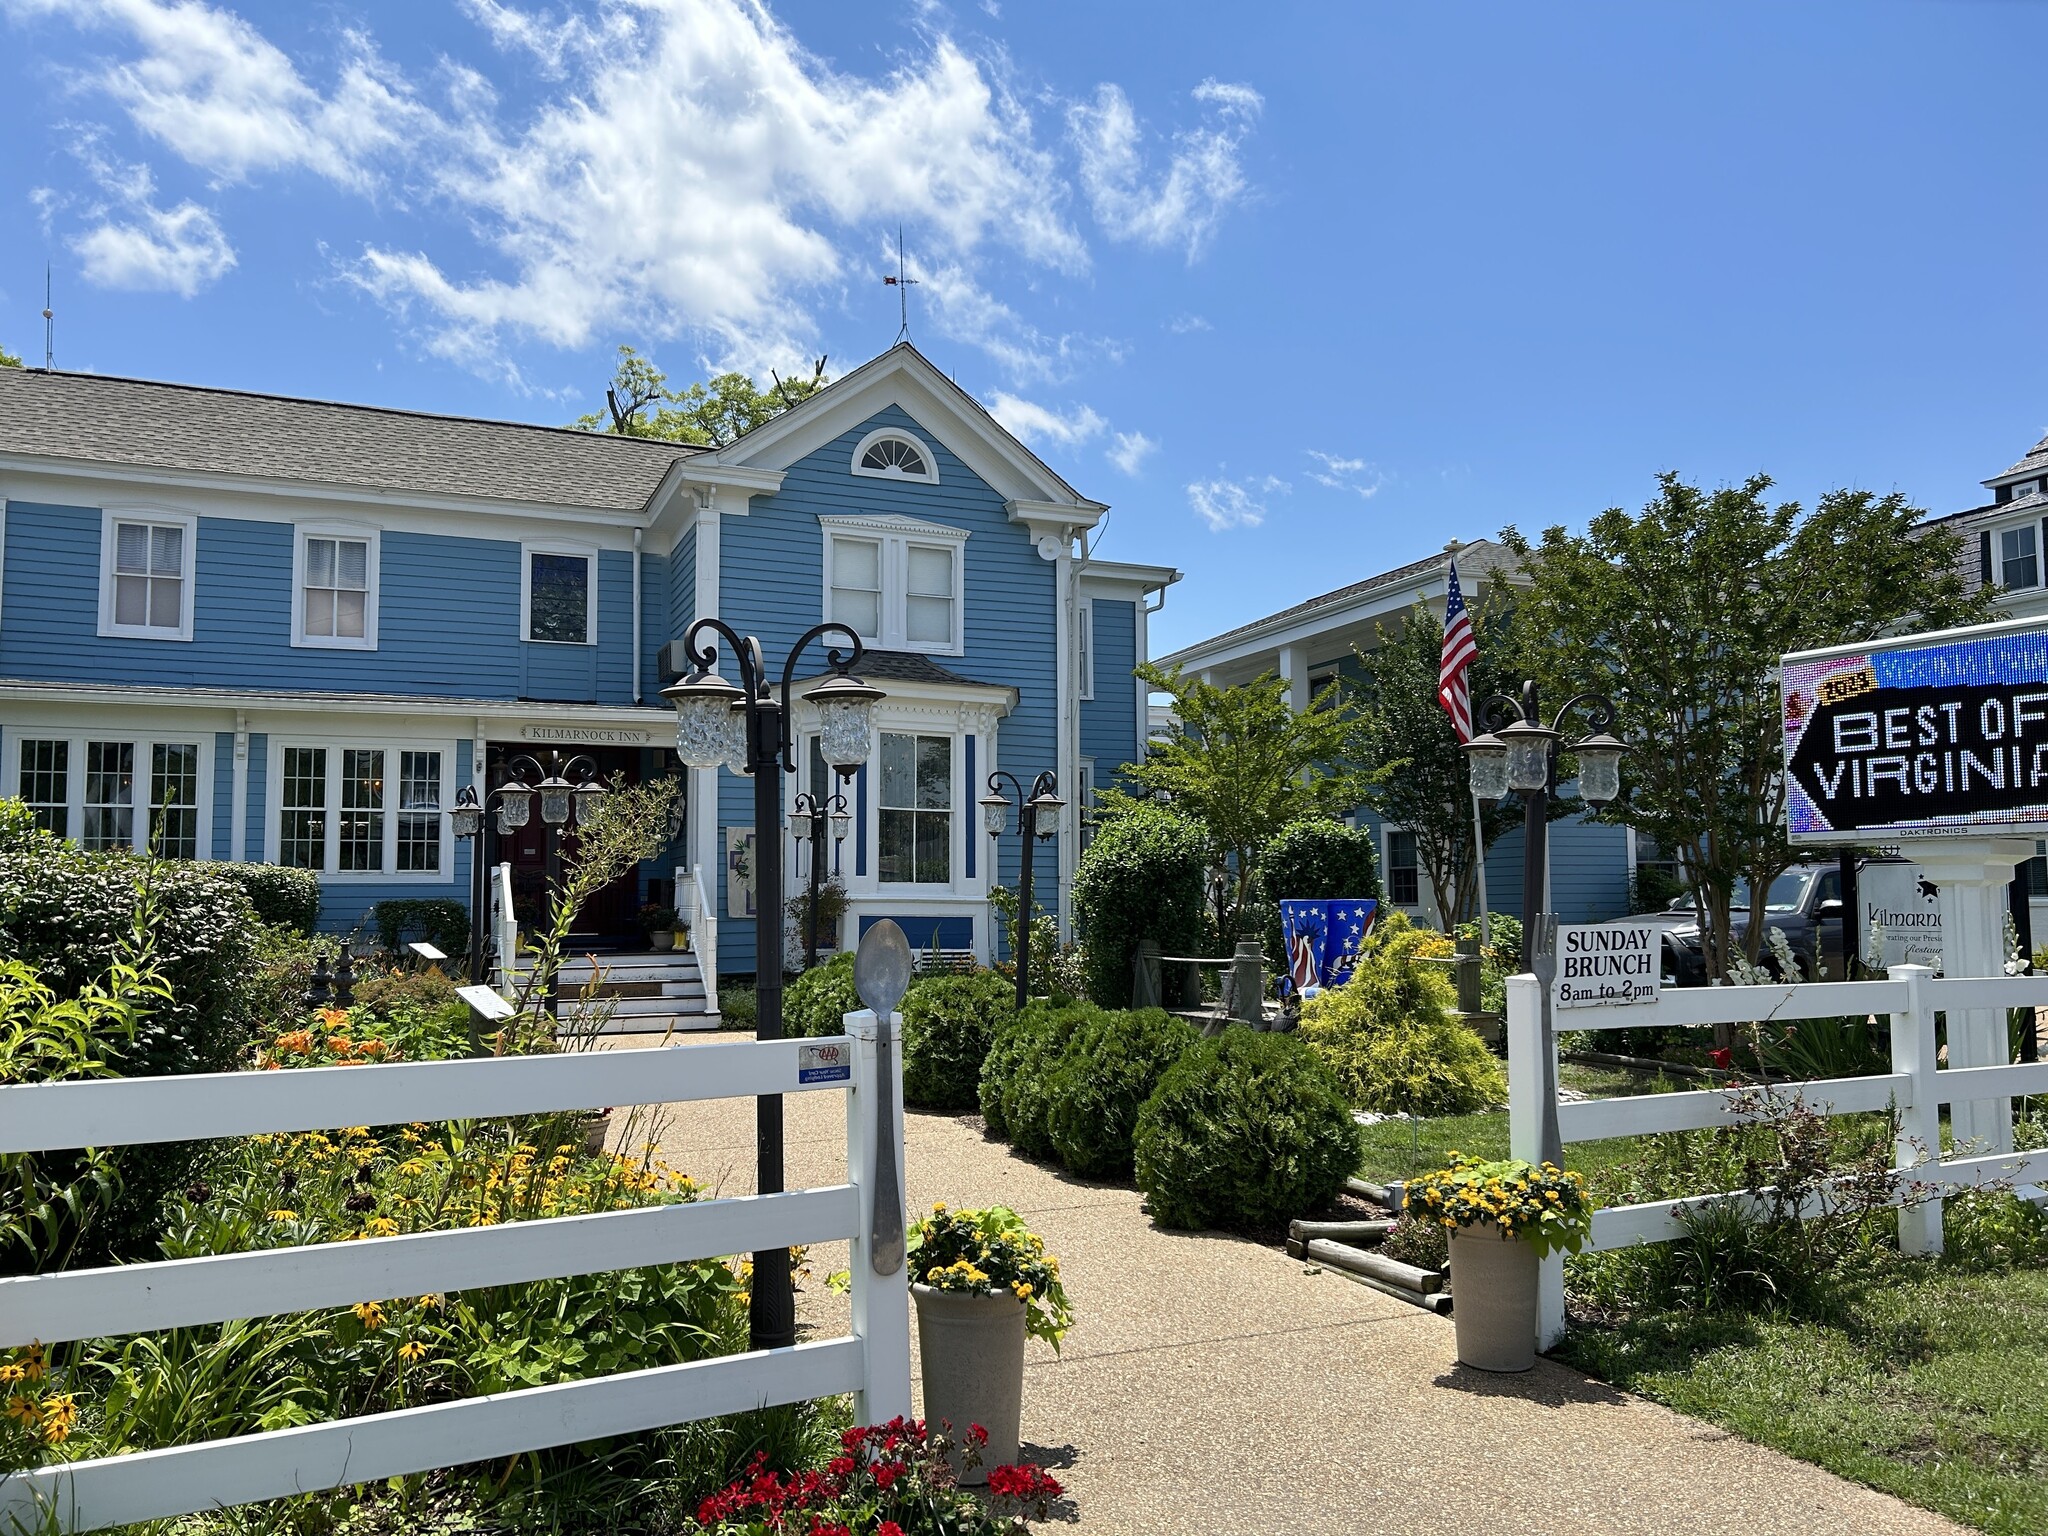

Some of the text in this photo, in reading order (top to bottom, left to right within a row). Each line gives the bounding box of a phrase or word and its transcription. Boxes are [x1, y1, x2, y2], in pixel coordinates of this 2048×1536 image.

[1824, 671, 1869, 701] 2023
[532, 727, 641, 742] KILMARNOCK INN
[1833, 692, 2048, 754] BEST OF
[1900, 827, 1968, 836] DAKTRONICS
[1566, 929, 1652, 953] SUNDAY
[1563, 953, 1652, 978] BRUNCH
[1560, 980, 1654, 1001] 8am to 2pm
